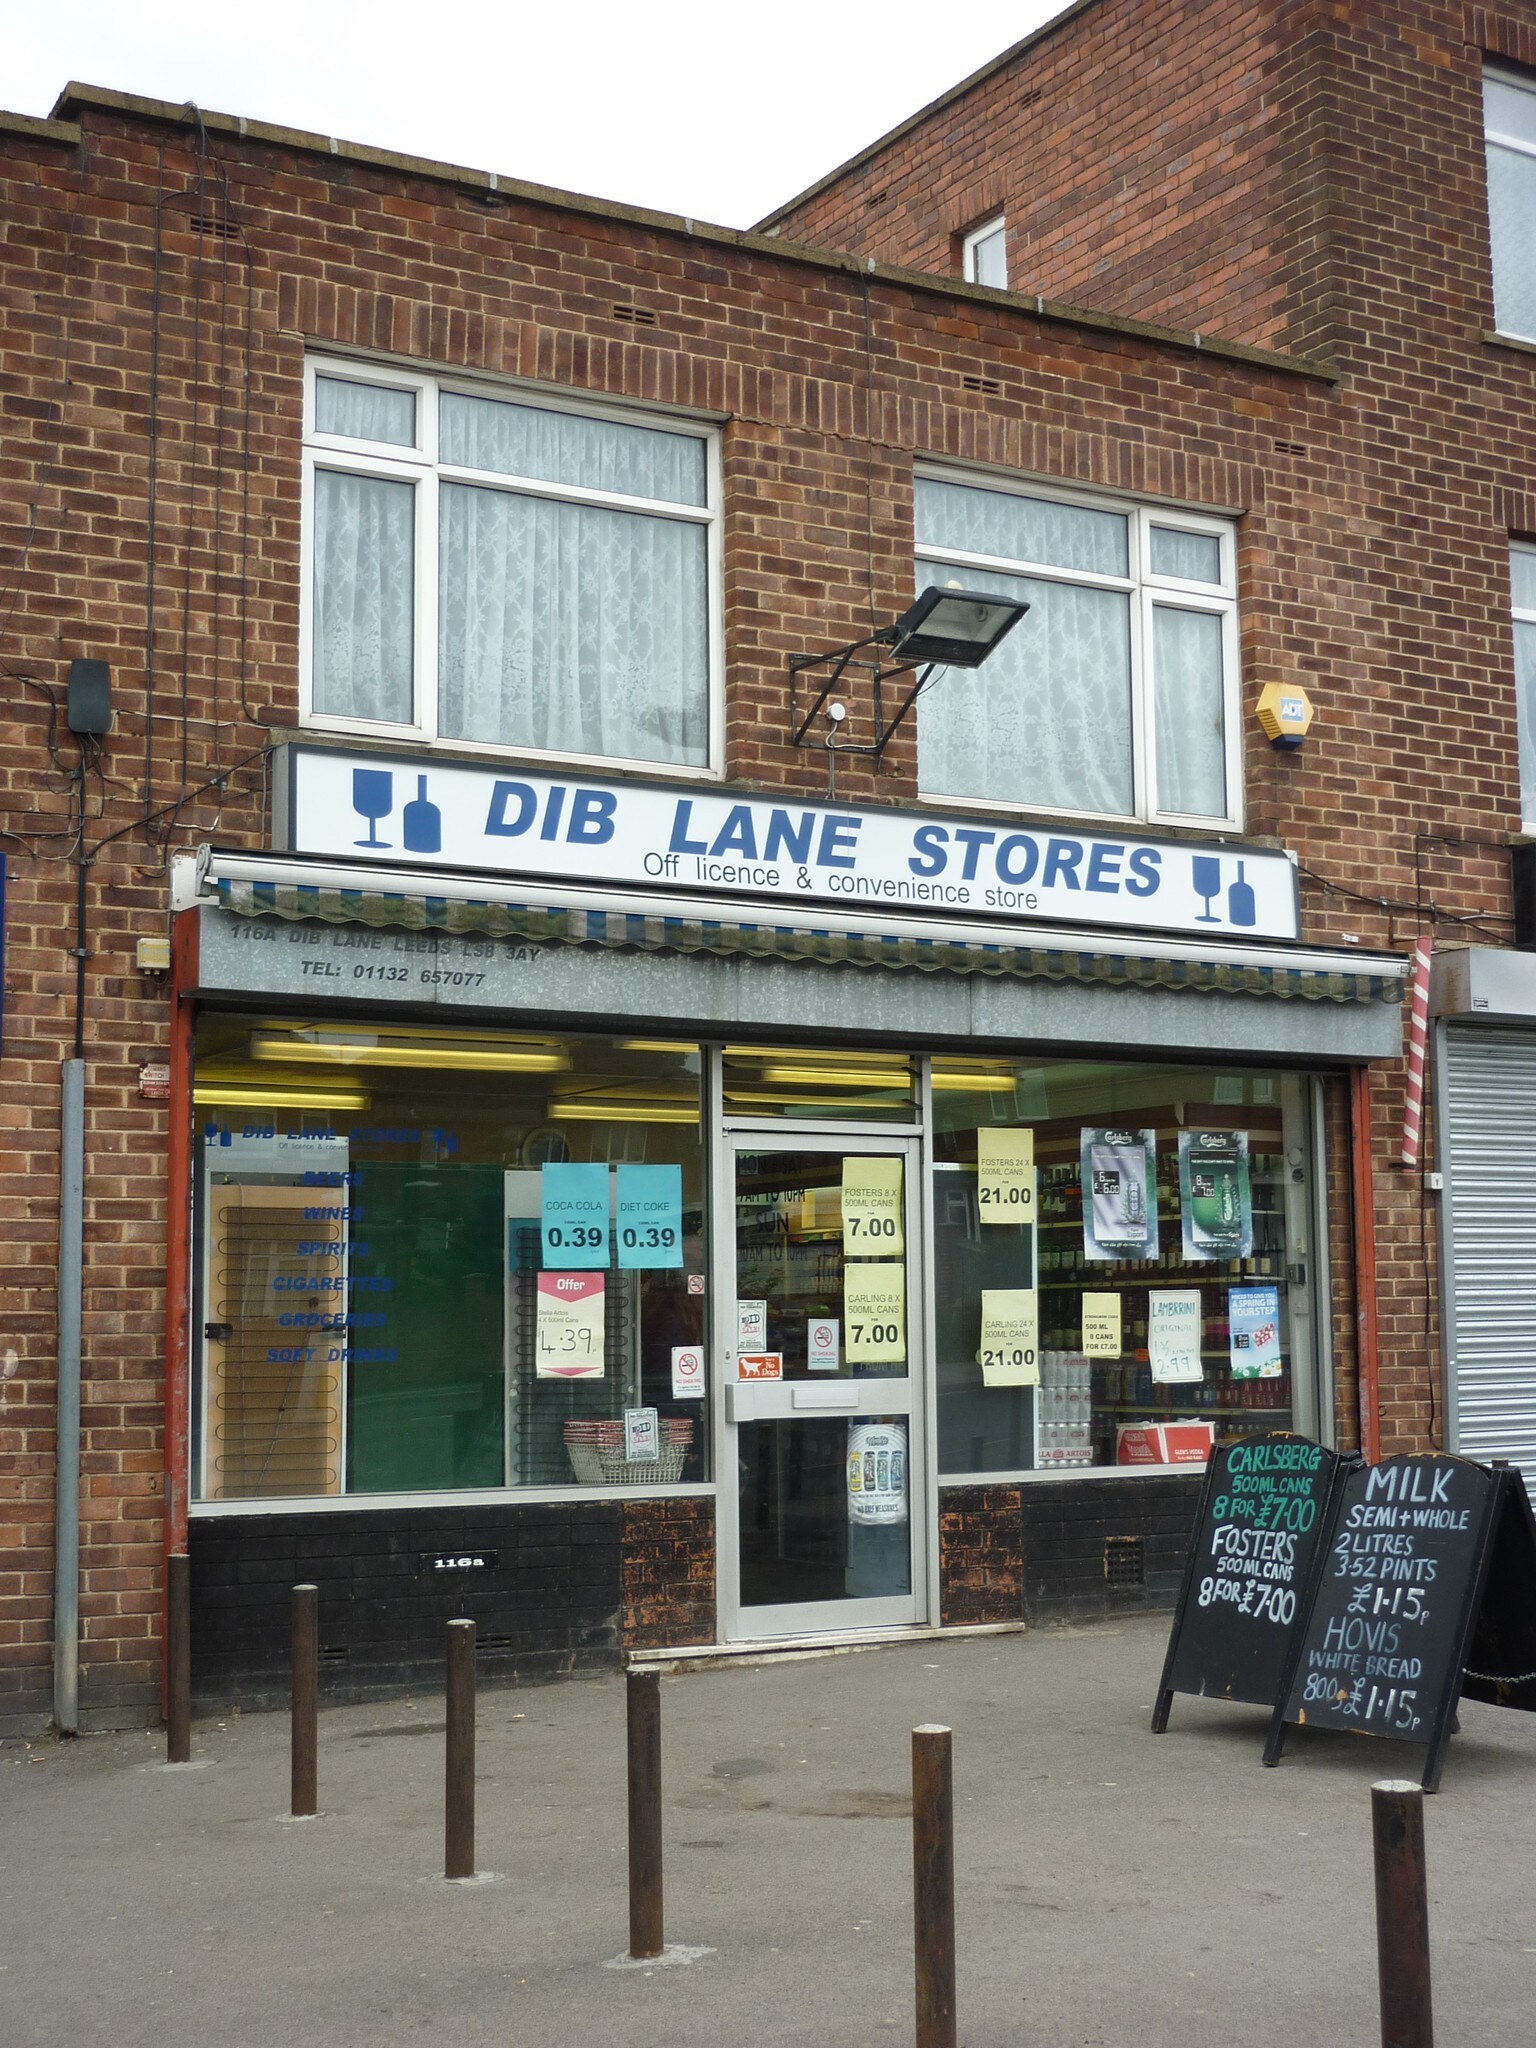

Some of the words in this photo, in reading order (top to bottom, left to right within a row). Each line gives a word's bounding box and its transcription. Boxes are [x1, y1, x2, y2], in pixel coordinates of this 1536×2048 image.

[1282, 703, 1303, 717] ADT
[484, 780, 618, 845] DIB
[668, 799, 862, 869] LANE
[908, 825, 1162, 898] STORES
[644, 852, 680, 878] Off
[696, 859, 780, 887] licence
[796, 867, 813, 890] &
[828, 873, 970, 904] convenience
[985, 886, 1038, 910] store
[230, 925, 276, 942] 116A
[289, 929, 321, 945] DIB
[333, 932, 383, 950] LANE
[394, 936, 450, 955] LEEDS
[506, 946, 541, 962] 3AY
[301, 960, 341, 976] TEL:
[353, 964, 409, 982] 01132
[420, 969, 486, 987] 657077
[242, 1124, 275, 1139] DIB
[287, 1126, 336, 1140] LANE
[1105, 1131, 1132, 1145] Carlsberg
[1200, 1134, 1226, 1148] Carlsberg
[982, 1158, 1014, 1166] FOSTERS
[844, 1188, 883, 1197] FOSTERS
[884, 1188, 890, 1196] 8
[892, 1189, 897, 1197] X
[980, 1187, 1031, 1204] 21.00
[546, 1201, 574, 1210] COCA
[576, 1201, 602, 1210] COLA
[620, 1202, 641, 1212] DIET
[644, 1202, 670, 1212] COKE
[844, 1198, 869, 1207] 500ML
[870, 1199, 894, 1208] CANS
[304, 1206, 362, 1221] WINES
[848, 1218, 896, 1237] 7.00
[548, 1227, 602, 1248] 0.39
[622, 1228, 676, 1248] 0.39
[297, 1242, 370, 1256] SPIRITS
[272, 1277, 392, 1291] CIGARETTES
[557, 1278, 586, 1290] Offer
[848, 1294, 886, 1303] CARLING
[894, 1294, 900, 1302] X
[1238, 1299, 1266, 1308] SPRING
[848, 1305, 874, 1314] 500ML
[876, 1305, 900, 1314] CANS
[1232, 1308, 1254, 1316] YOUR
[1254, 1306, 1276, 1316] STEP
[278, 1312, 386, 1328] GROCERIES
[985, 1320, 1018, 1328] CARLING
[851, 1324, 898, 1344] 7.00
[266, 1348, 314, 1362] SOFT
[983, 1349, 1034, 1366] 21.00
[762, 1368, 778, 1376] Dogs
[1227, 1444, 1322, 1473] CARLSBERG
[1232, 1475, 1278, 1494] 500ML
[1280, 1477, 1313, 1495] CANS
[1365, 1465, 1454, 1502] MILK
[1212, 1495, 1229, 1520] 8
[1230, 1498, 1256, 1518] FOR
[1211, 1524, 1298, 1564] FOSTERS
[1334, 1532, 1351, 1554] 2
[1352, 1533, 1415, 1556] LITRES
[1216, 1556, 1262, 1577] 500ML
[1263, 1562, 1294, 1582] CANS
[1380, 1557, 1438, 1582] PINTS
[1198, 1576, 1214, 1607] 8
[1212, 1578, 1241, 1603] FOR
[1323, 1616, 1402, 1654] HOVIS
[1309, 1650, 1362, 1672] WHITE
[1366, 1655, 1422, 1680] BREAD
